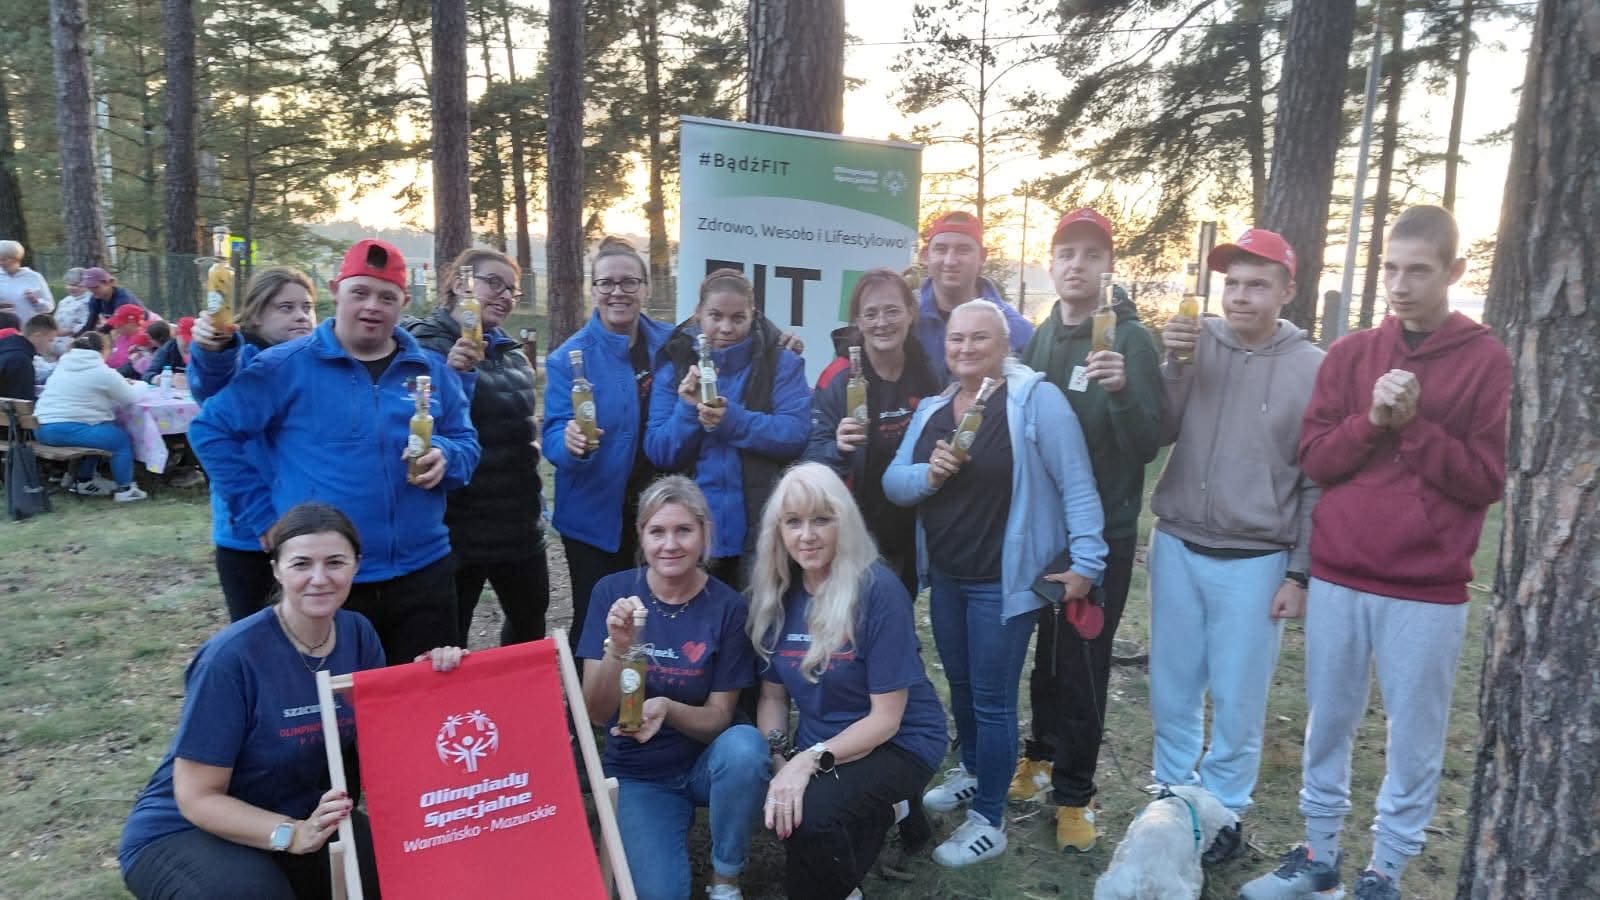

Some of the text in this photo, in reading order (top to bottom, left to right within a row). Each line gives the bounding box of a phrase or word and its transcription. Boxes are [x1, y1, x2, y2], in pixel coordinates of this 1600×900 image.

[698, 152, 791, 176] #BądźFIT
[697, 217, 758, 238] Zdrowo,
[761, 223, 814, 241] Wesoło
[816, 228, 822, 241] i
[706, 259, 822, 327] IT
[420, 772, 529, 808] Olimpiady
[424, 792, 532, 828] Specjalne
[490, 804, 557, 832] Mazurskie
